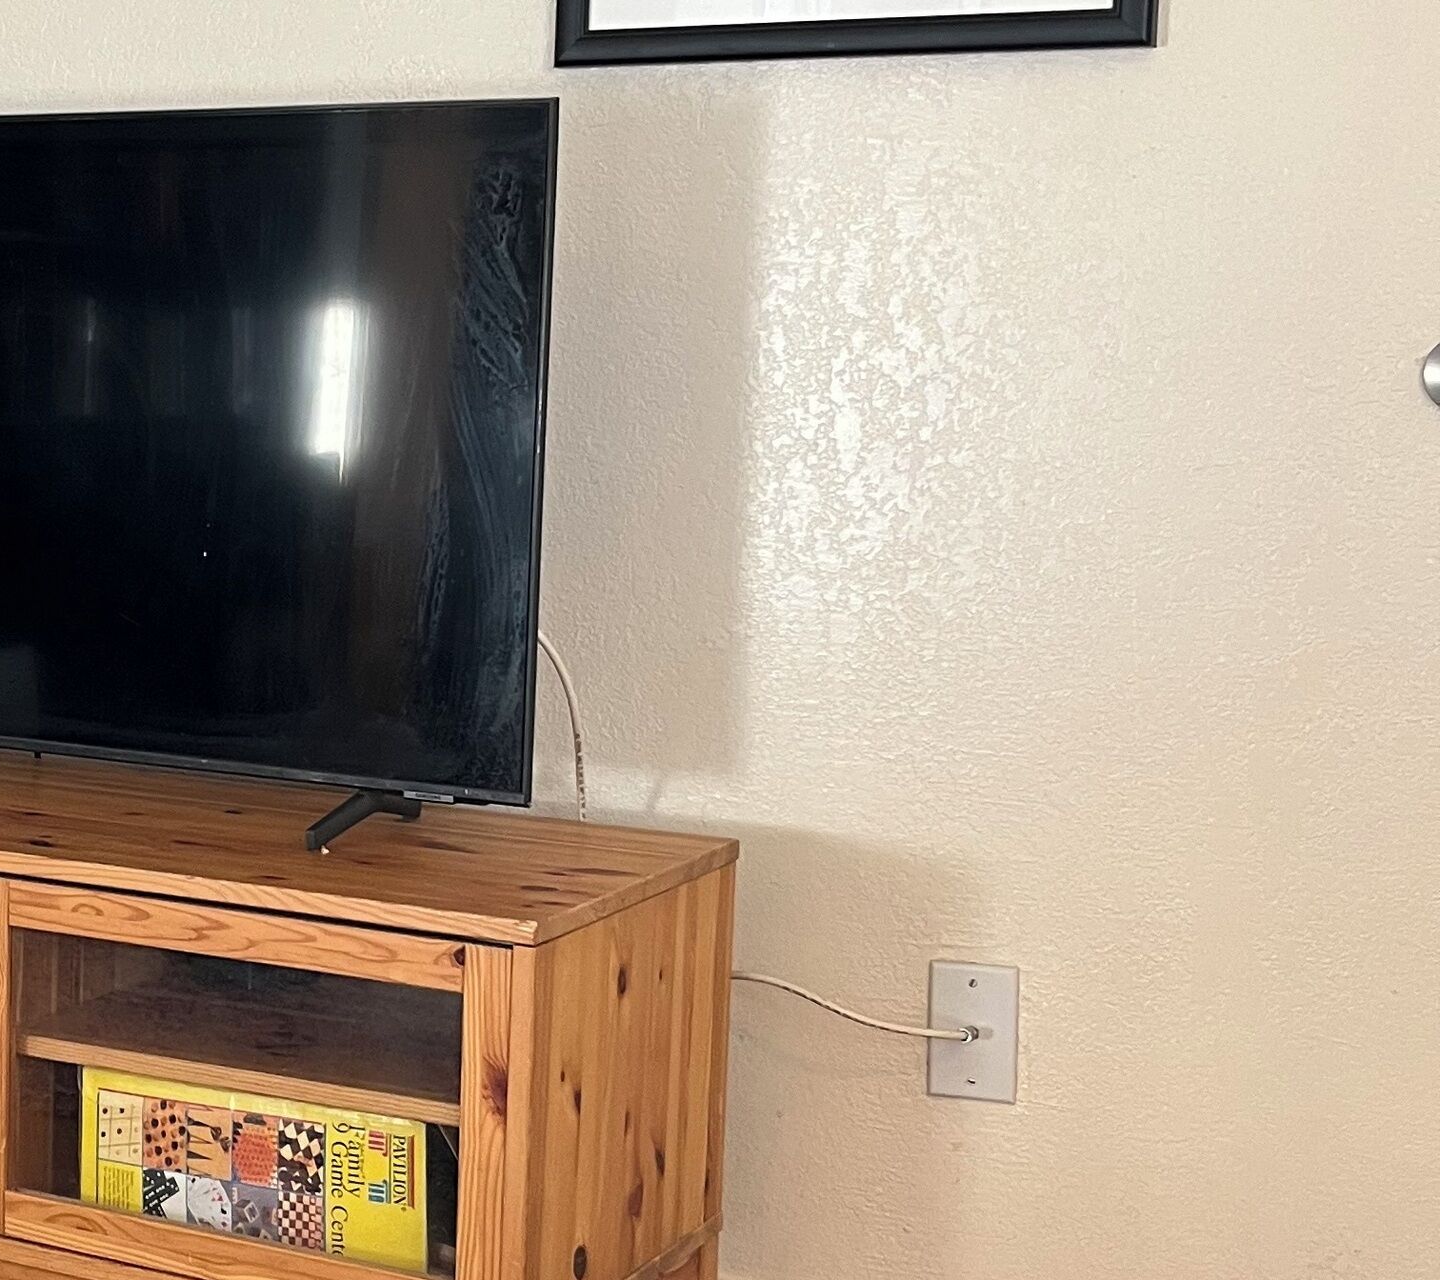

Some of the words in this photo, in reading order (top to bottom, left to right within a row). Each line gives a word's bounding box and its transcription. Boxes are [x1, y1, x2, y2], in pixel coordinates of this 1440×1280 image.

[332, 1122, 350, 1134] 9
[330, 1141, 349, 1199] Game
[343, 1125, 366, 1199] Family
[392, 1135, 407, 1205] PAVILION
